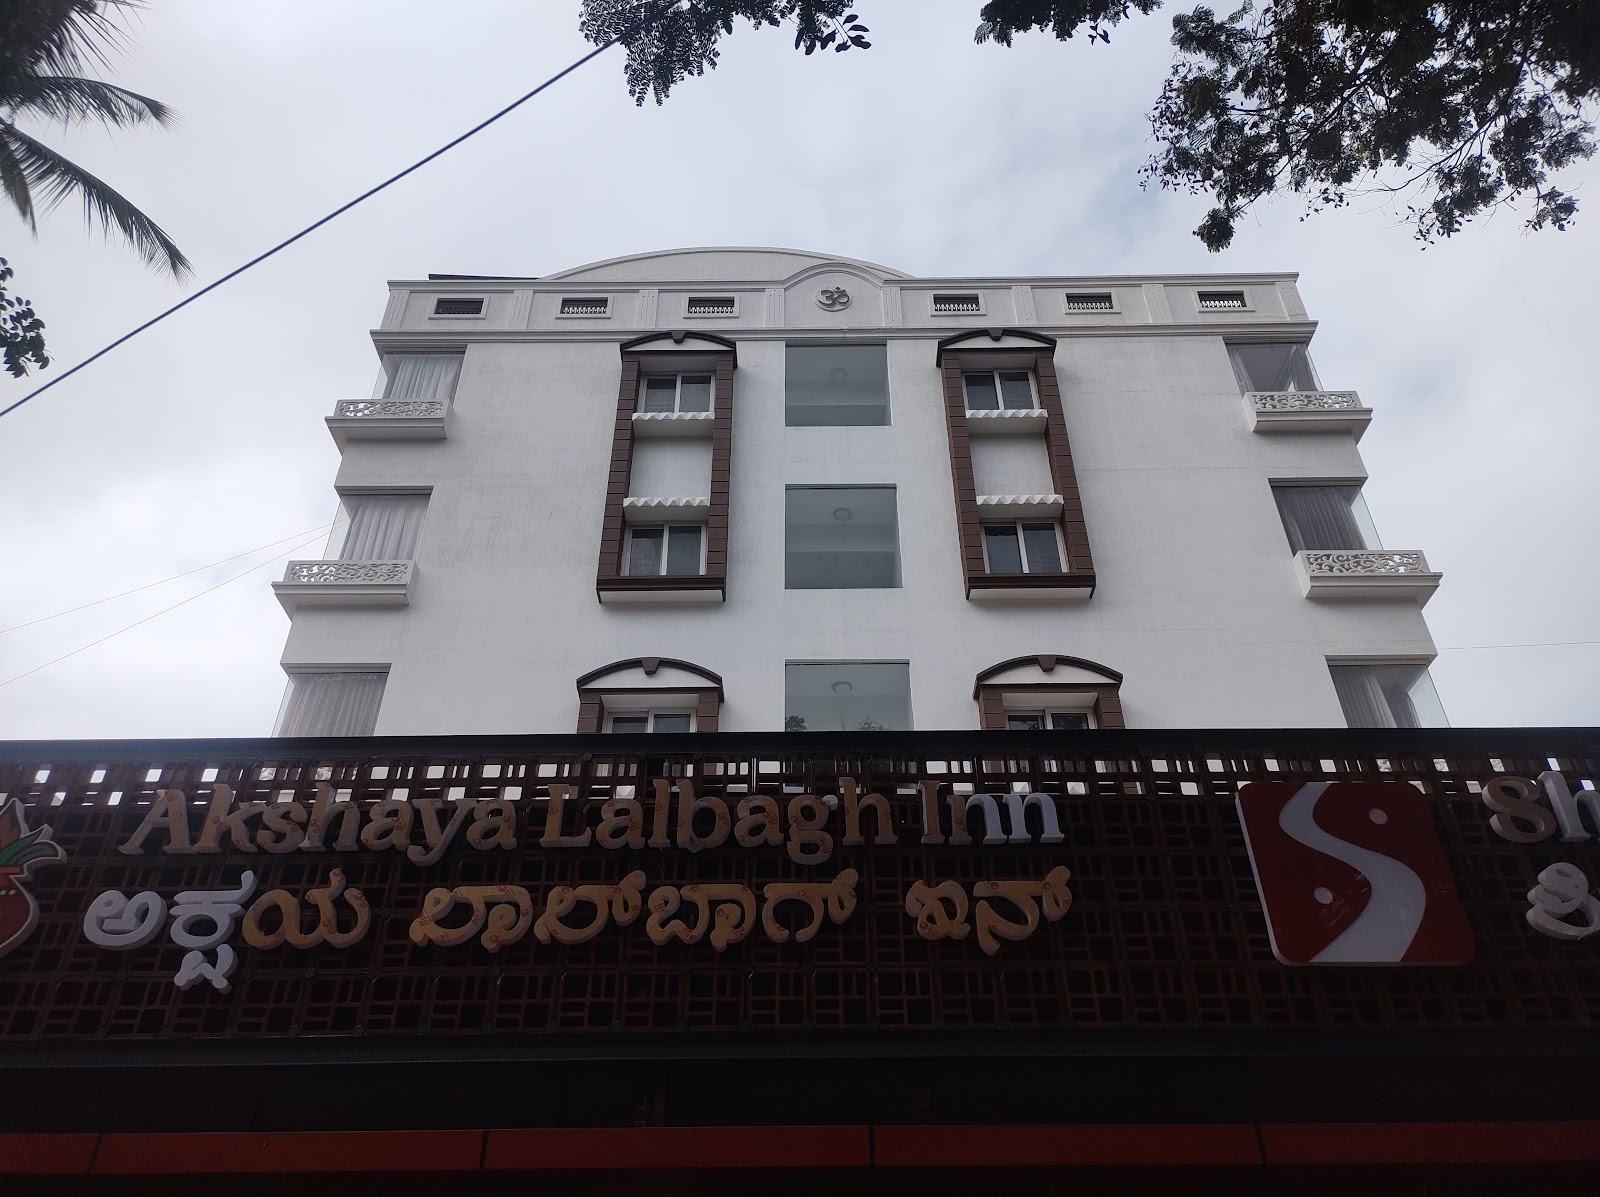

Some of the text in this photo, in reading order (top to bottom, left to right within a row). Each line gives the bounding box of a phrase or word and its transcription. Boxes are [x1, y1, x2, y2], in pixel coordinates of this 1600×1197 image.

[118, 776, 1064, 867] Akshaya Lalbagh Inn
[83, 869, 371, 995] ಅಕ್ಷಯ
